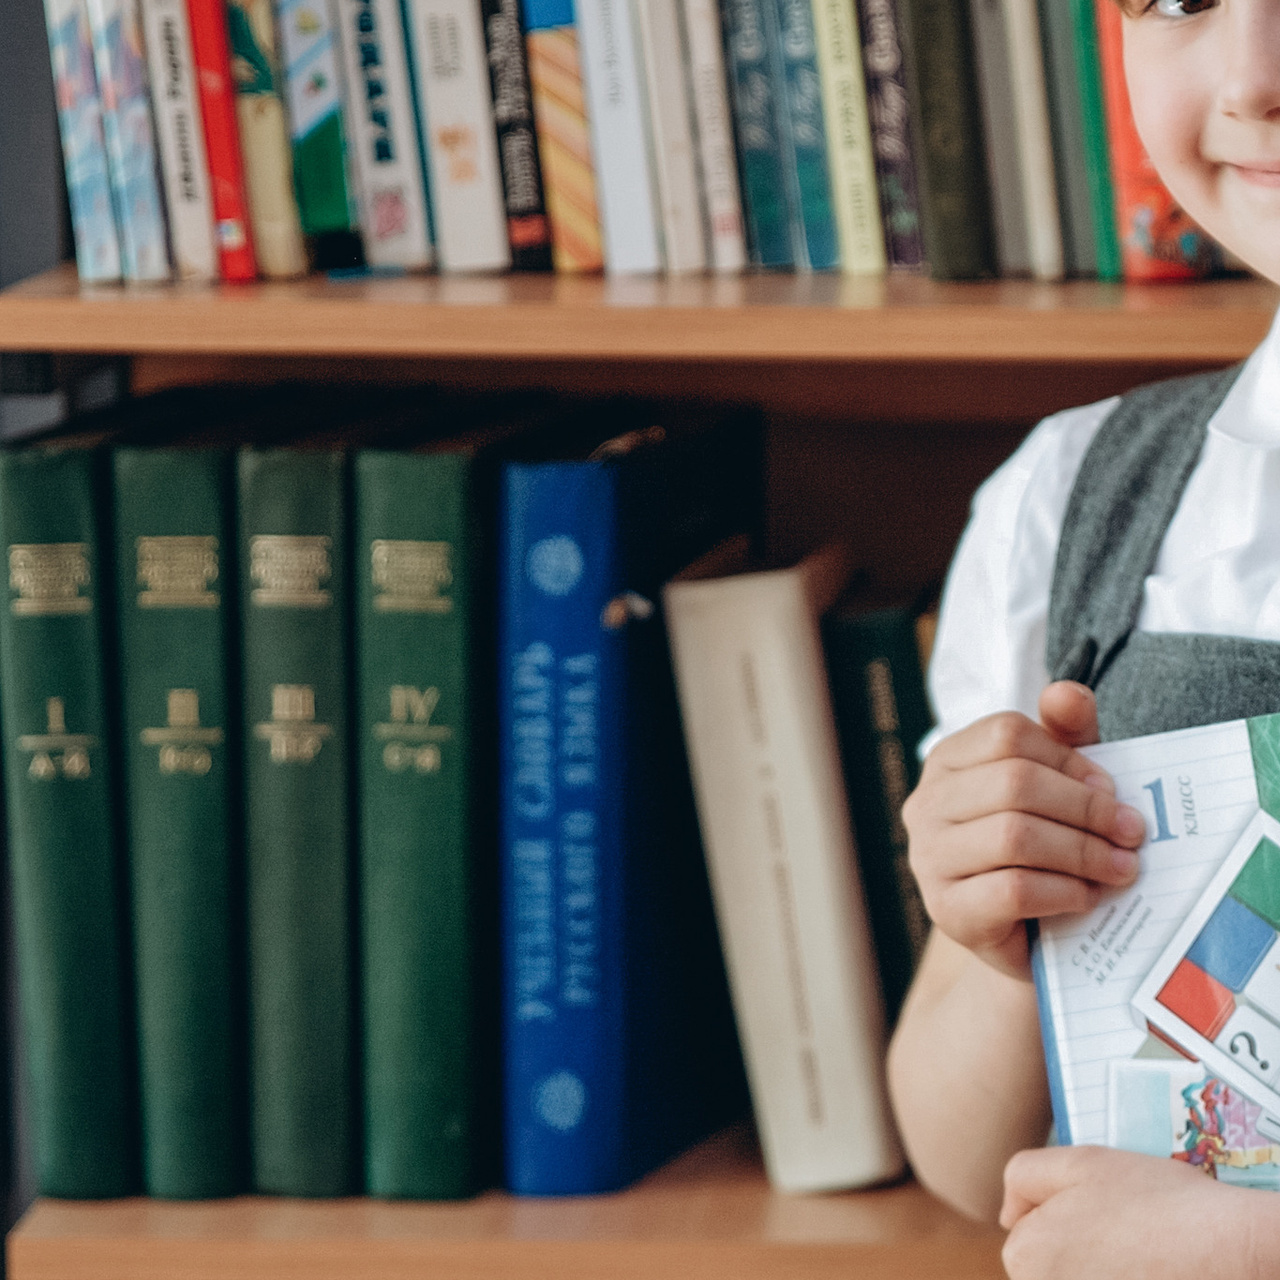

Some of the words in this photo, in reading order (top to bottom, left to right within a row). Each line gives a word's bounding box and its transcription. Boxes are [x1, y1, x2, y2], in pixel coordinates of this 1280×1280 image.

[389, 685, 441, 726] IV
[1142, 776, 1179, 843] 1
[1177, 775, 1200, 837] класс
